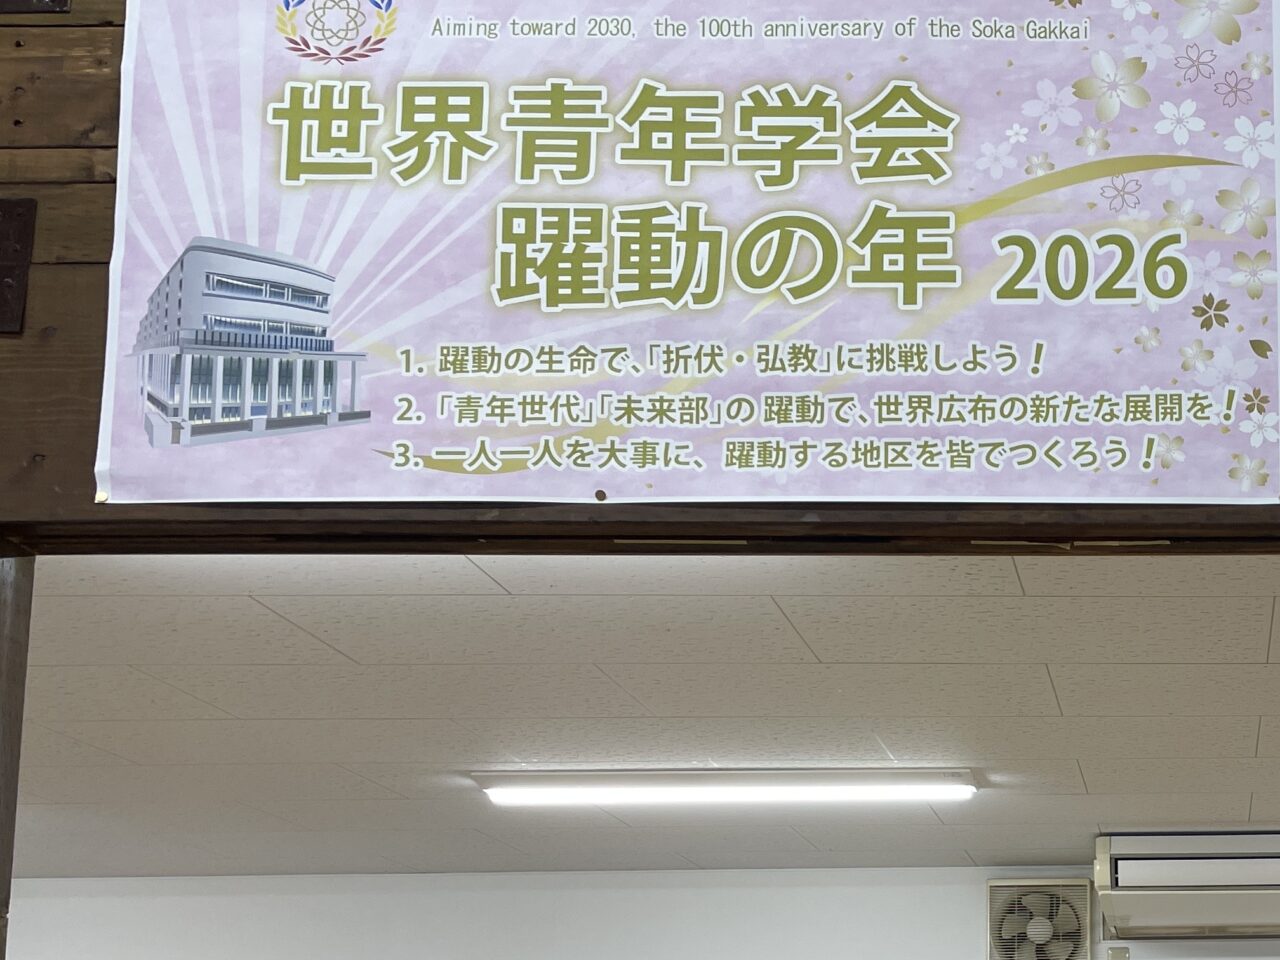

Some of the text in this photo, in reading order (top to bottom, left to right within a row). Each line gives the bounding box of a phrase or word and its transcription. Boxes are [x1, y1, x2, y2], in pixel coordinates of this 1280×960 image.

[431, 18, 1088, 39] Aiming toward 2030, the 100th anniversary of the Soka Gakkai
[271, 81, 957, 187] 世界青年学会
[497, 204, 1188, 307] 躍動の年 2026
[400, 349, 424, 373] 1.
[396, 397, 423, 421] 2.
[394, 443, 420, 467] 3.
